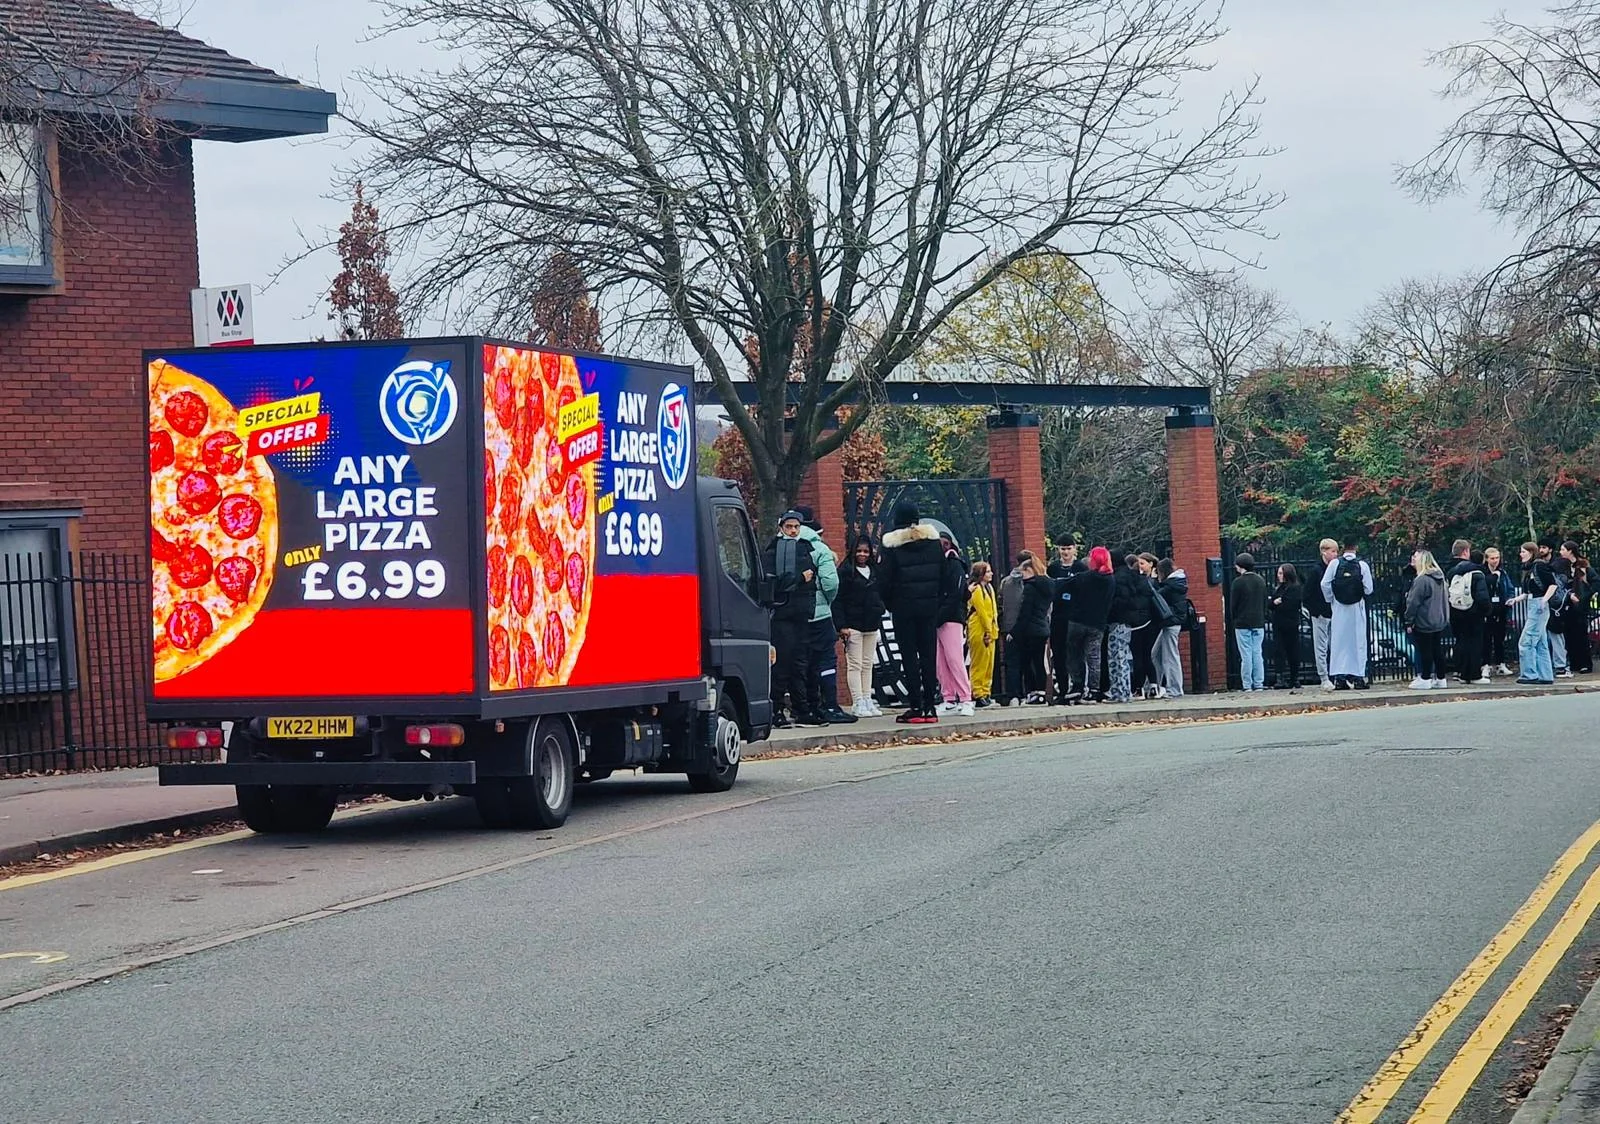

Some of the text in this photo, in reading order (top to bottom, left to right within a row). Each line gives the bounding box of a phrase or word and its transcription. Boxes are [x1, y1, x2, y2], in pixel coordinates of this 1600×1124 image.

[244, 402, 312, 427] SPECIAL
[562, 410, 594, 430] SPECIAL
[617, 391, 647, 425] ANY
[258, 422, 317, 449] OFFER
[568, 431, 597, 462] OFFER
[611, 428, 658, 464] LARGE
[333, 455, 410, 485] ANY
[613, 467, 656, 501] PIZZA
[316, 487, 438, 518] LARGE
[325, 521, 431, 551] PIZZA
[605, 512, 662, 556] £6.99
[301, 560, 446, 600] £6.99
[274, 718, 346, 735] YK22 HHM
